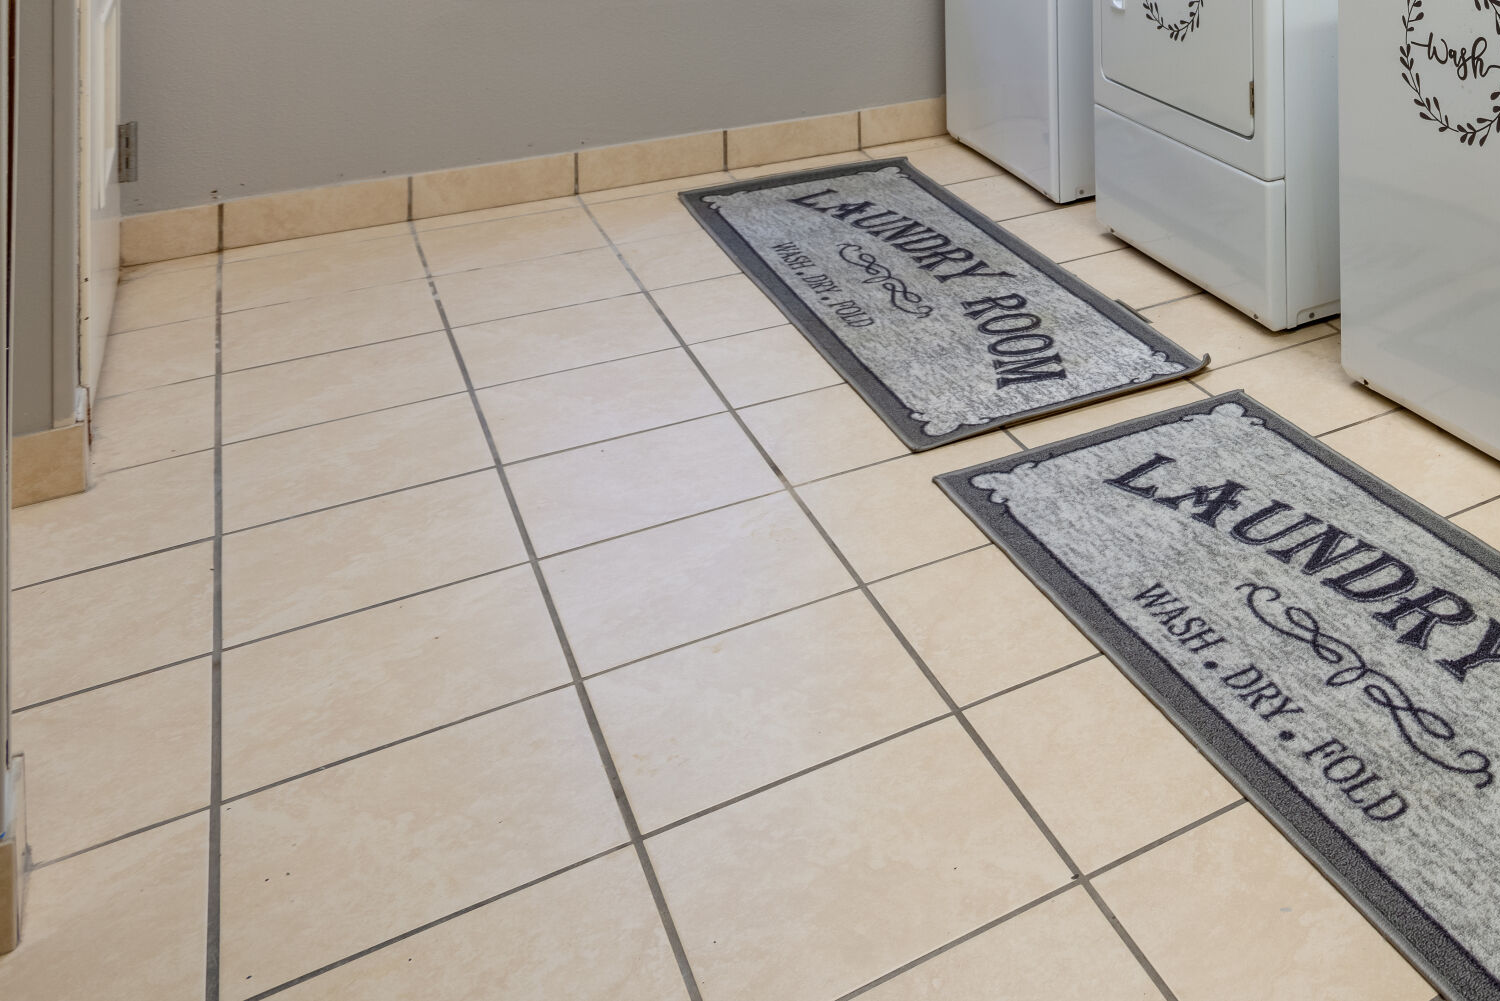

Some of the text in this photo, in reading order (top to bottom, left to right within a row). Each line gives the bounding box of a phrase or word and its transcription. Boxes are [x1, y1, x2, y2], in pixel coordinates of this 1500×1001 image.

[771, 241, 875, 327] WASH DRY FOLD
[787, 188, 1067, 391] LAUNDRY ROOM
[1136, 582, 1409, 822] WASH DRY FOLD
